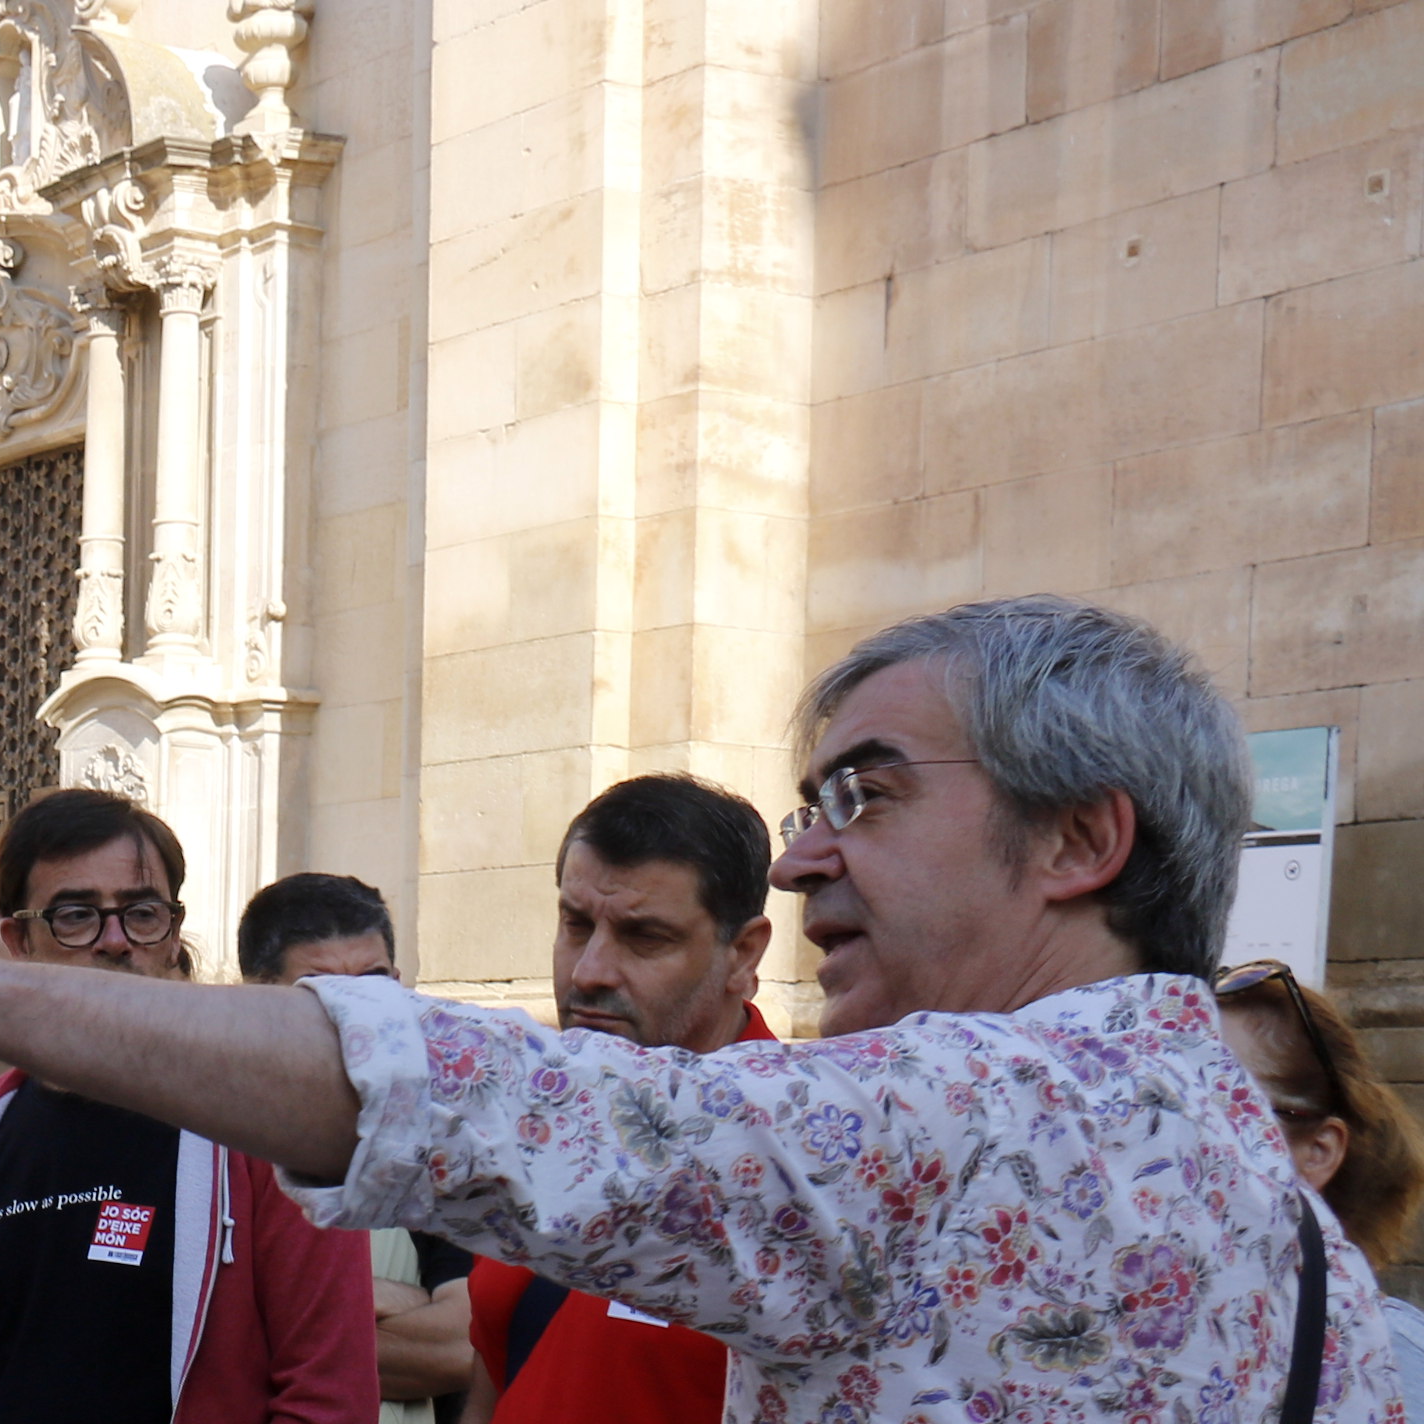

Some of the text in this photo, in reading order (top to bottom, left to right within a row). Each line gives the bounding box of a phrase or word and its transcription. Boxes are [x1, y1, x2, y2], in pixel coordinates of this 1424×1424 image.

[5, 1199, 38, 1217] slow
[41, 1195, 54, 1209] as
[56, 1185, 123, 1210] possible
[100, 1205, 150, 1222] JO SÓC
[98, 1219, 142, 1235] D'EIXE
